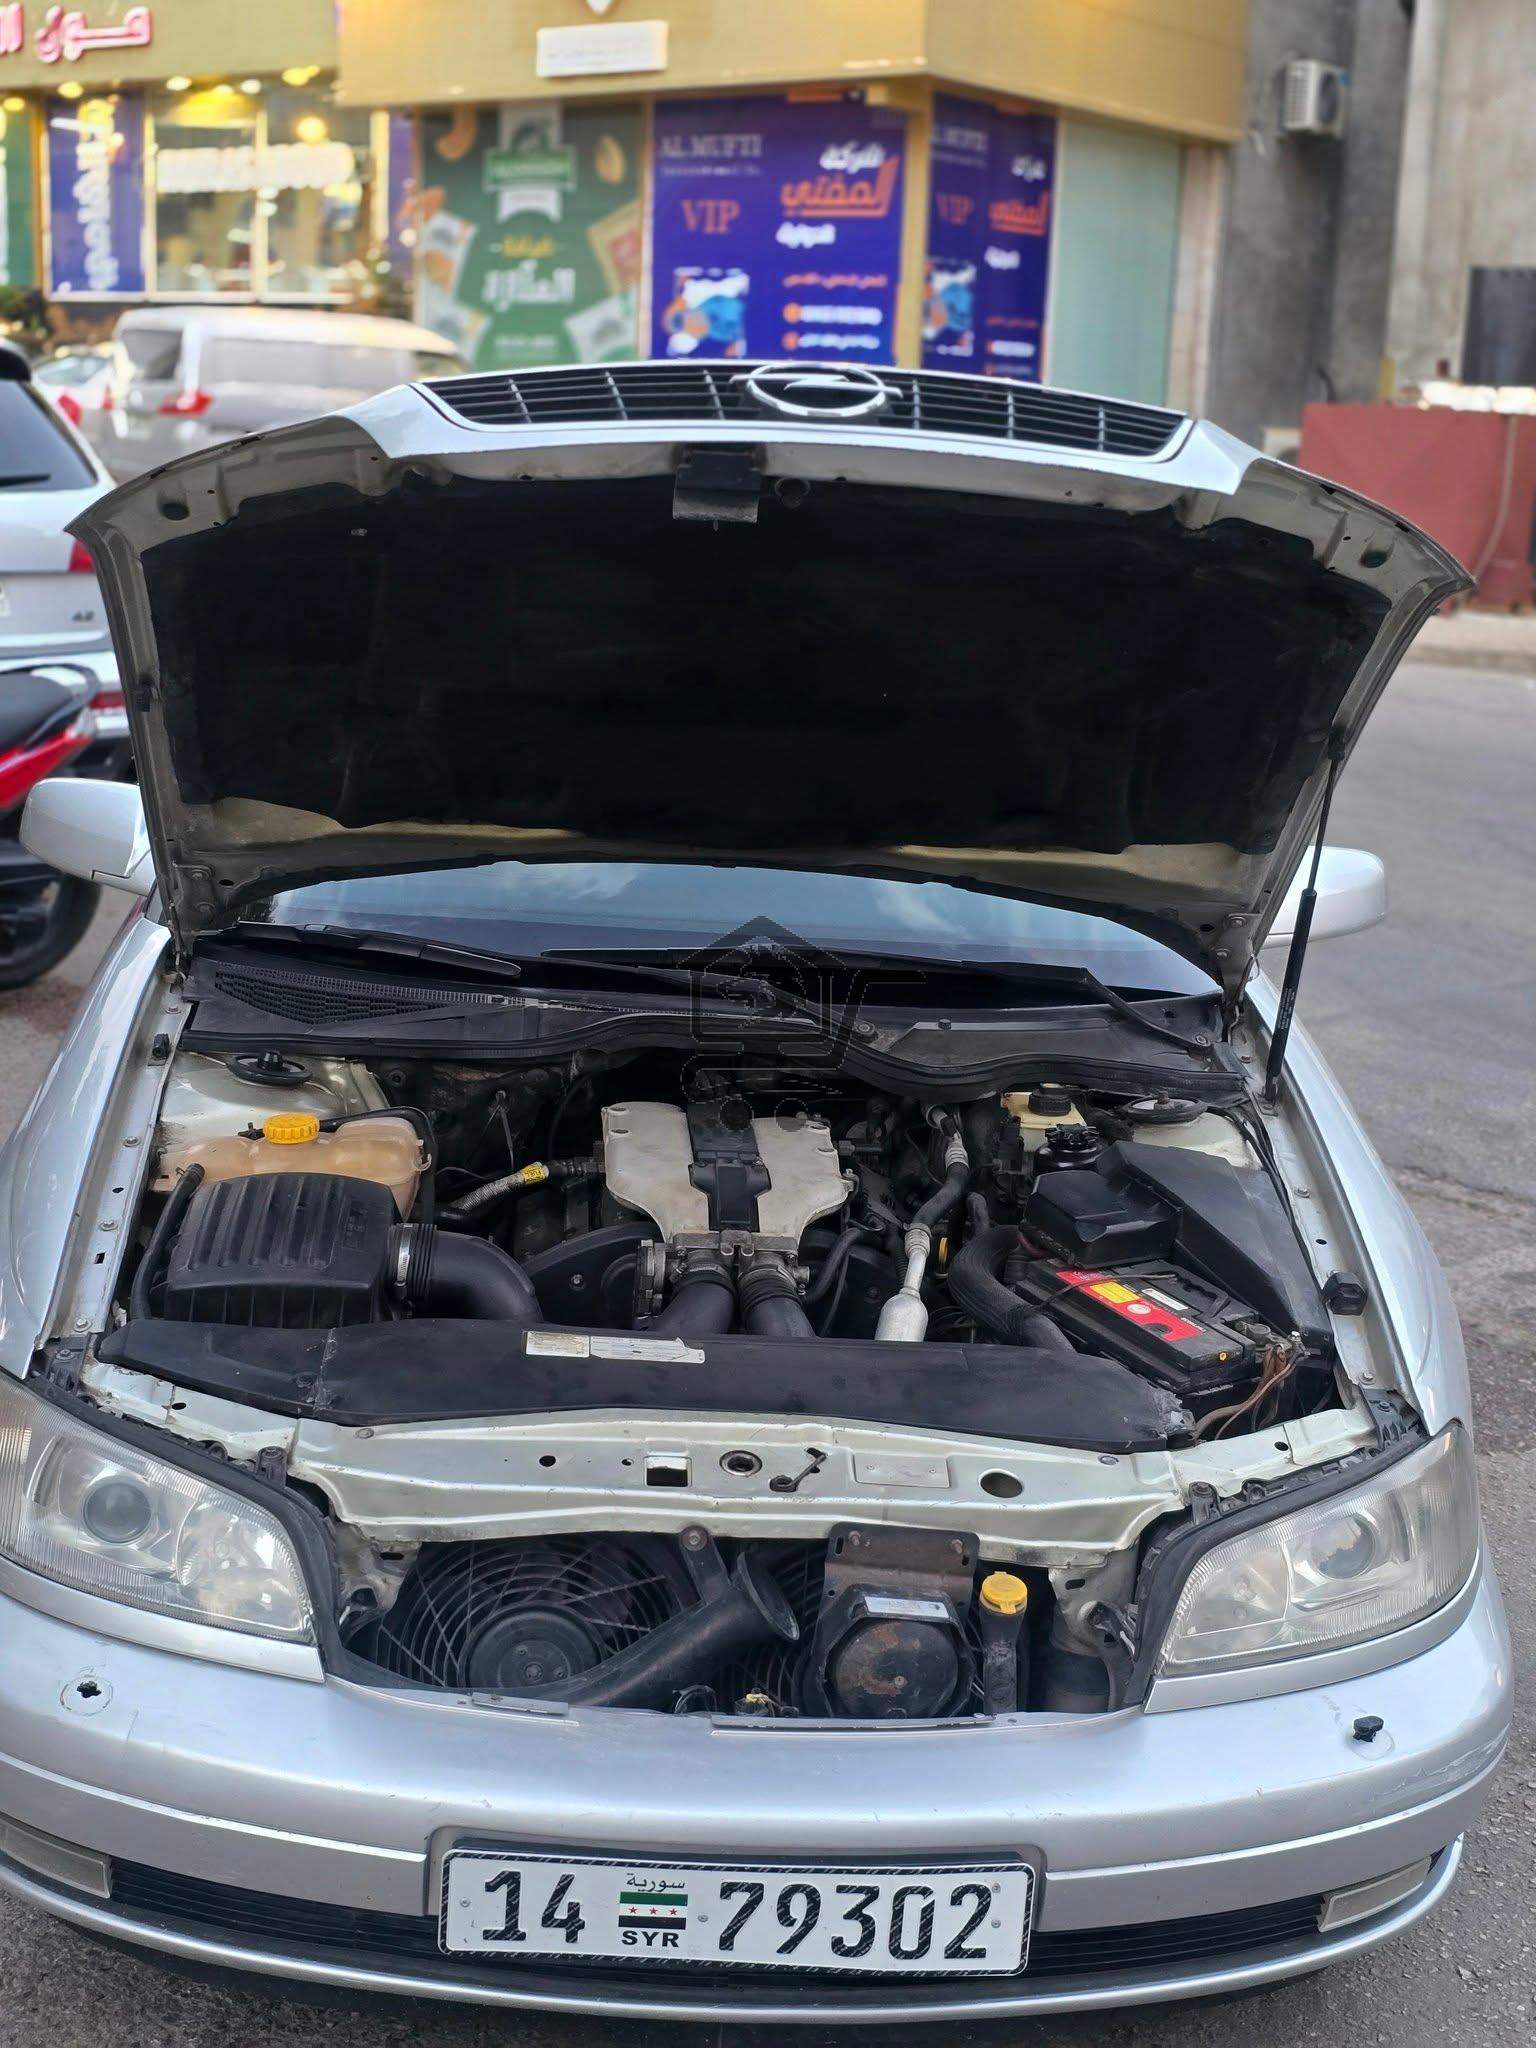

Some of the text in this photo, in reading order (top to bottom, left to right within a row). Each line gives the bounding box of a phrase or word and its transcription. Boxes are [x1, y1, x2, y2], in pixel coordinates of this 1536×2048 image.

[681, 199, 741, 235] VIP
[936, 193, 974, 226] VIP
[626, 1872, 686, 1893] سورية
[482, 1869, 587, 1945] 14
[717, 1880, 995, 1960] 79302
[621, 1930, 680, 1948] SYR
